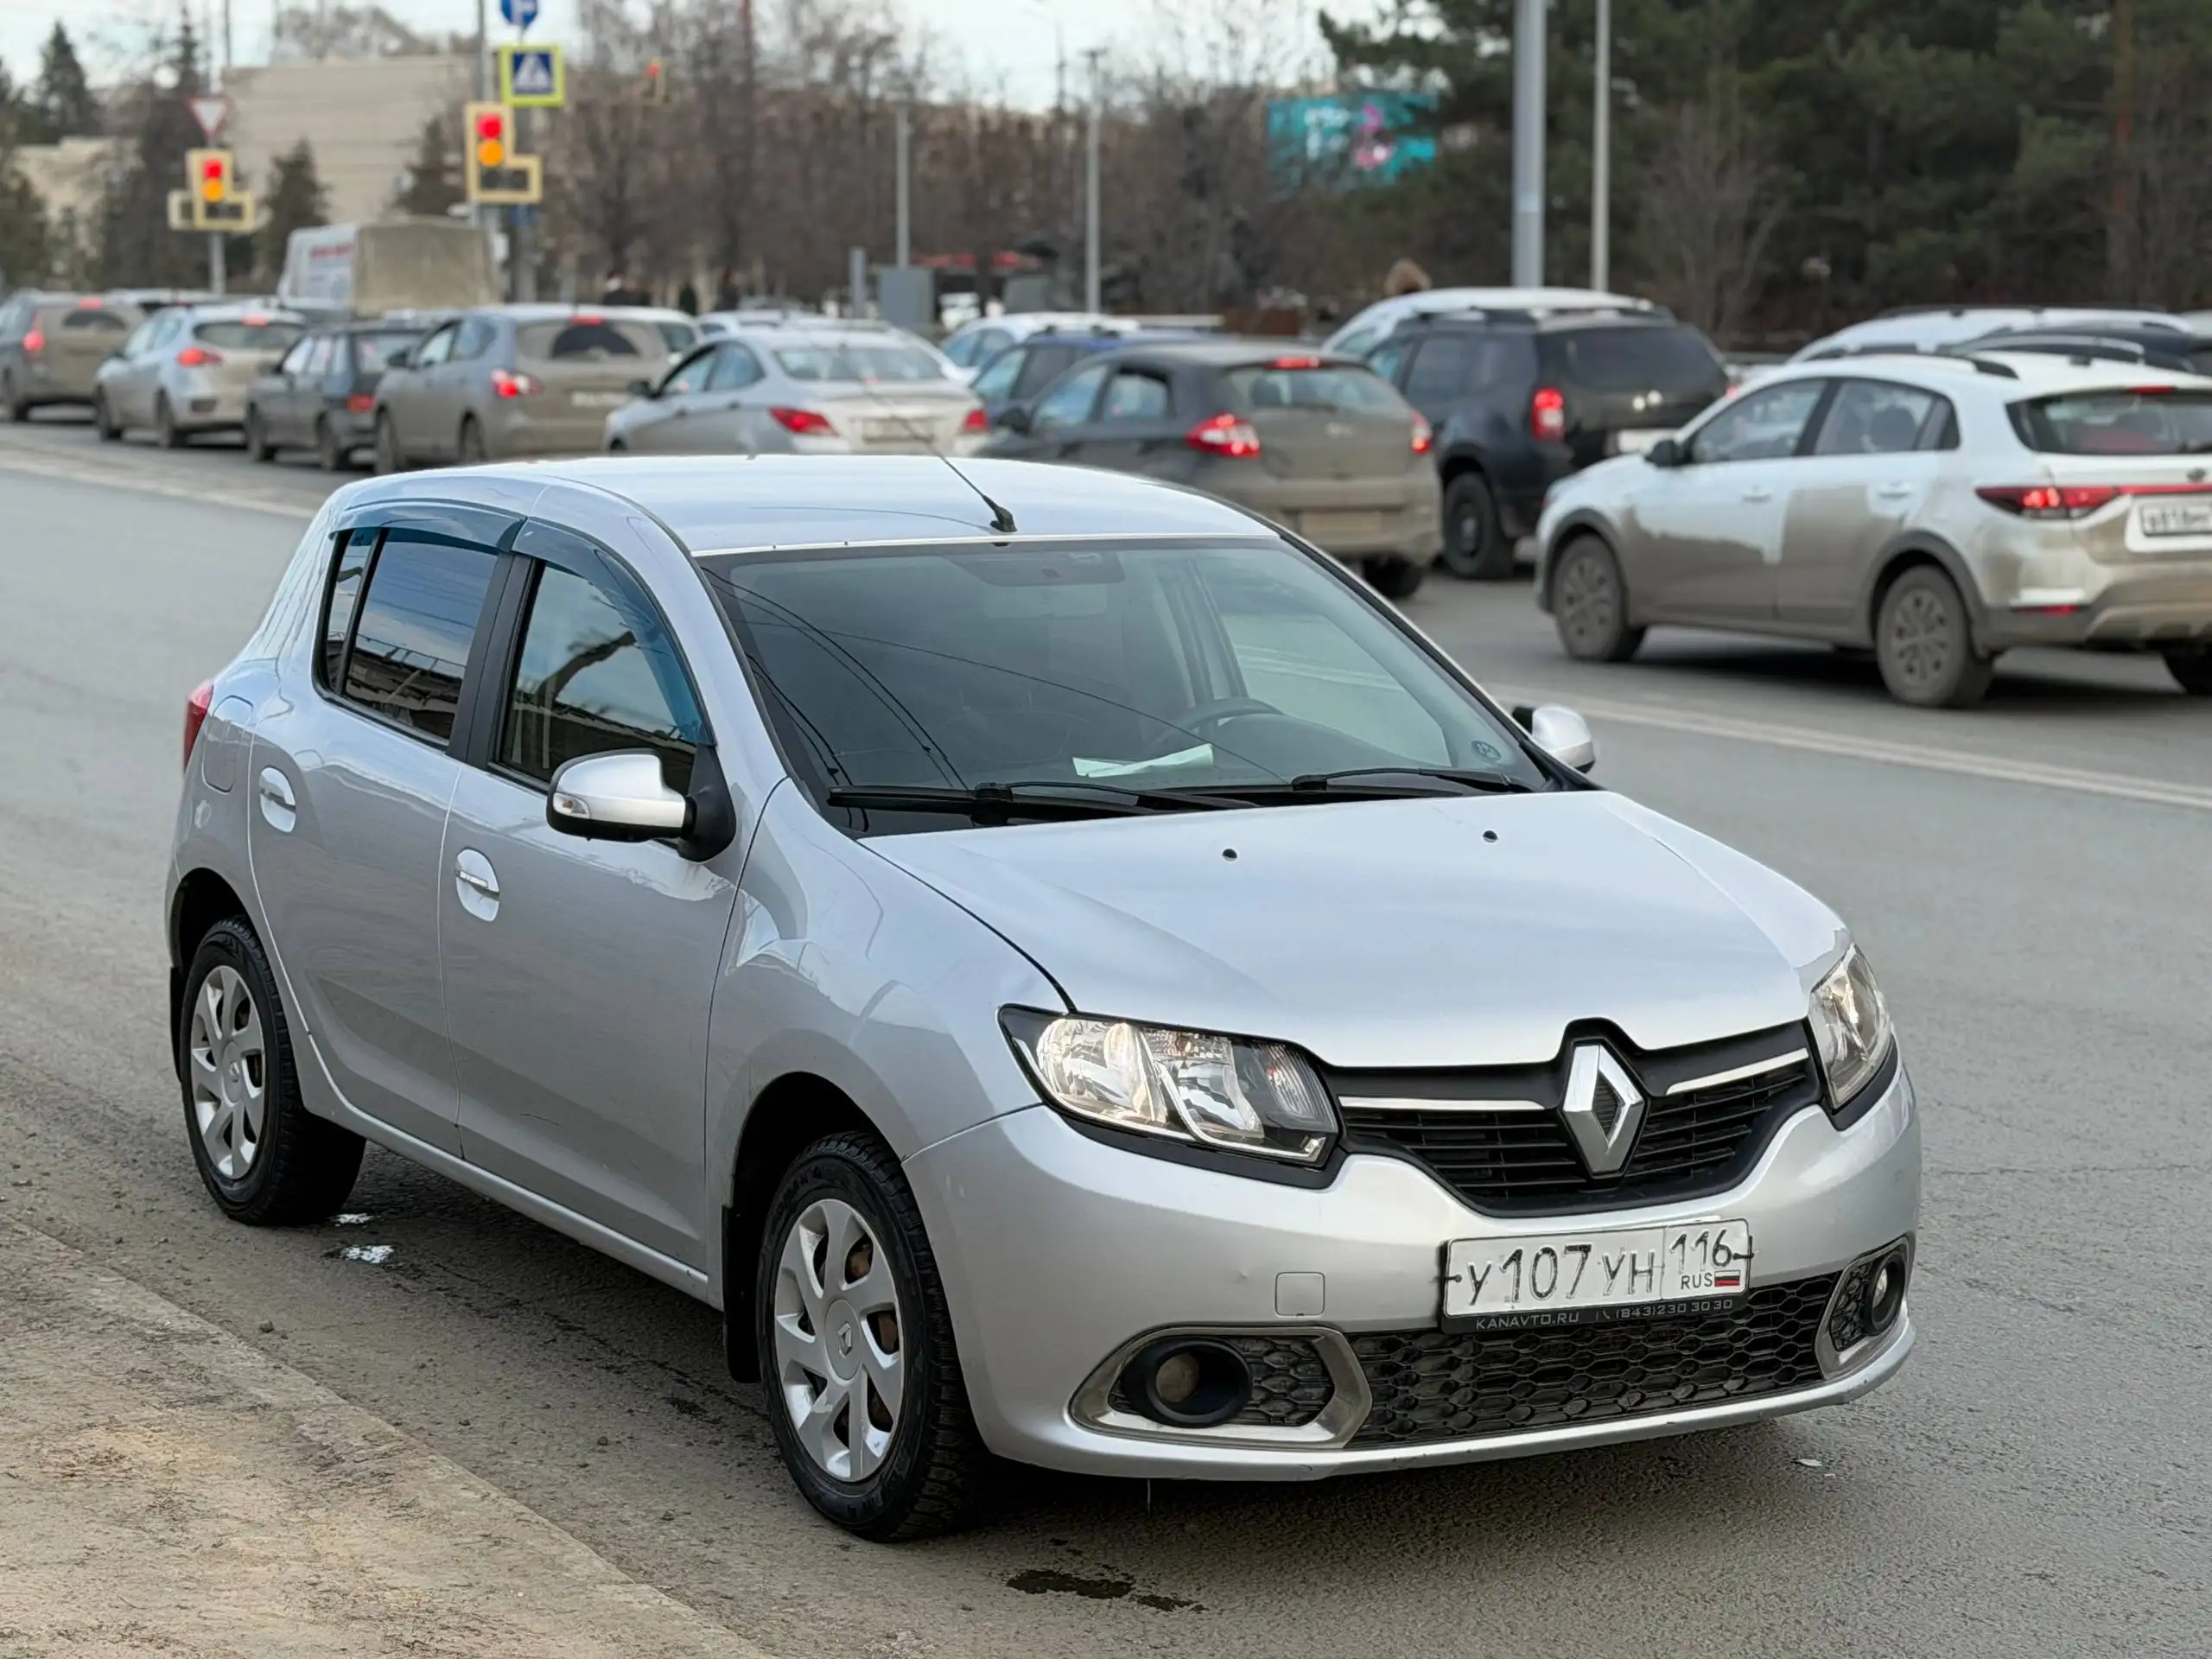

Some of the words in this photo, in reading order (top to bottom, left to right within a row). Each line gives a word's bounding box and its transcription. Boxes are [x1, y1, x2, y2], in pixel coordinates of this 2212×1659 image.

[1669, 1229, 1732, 1274] 116
[1681, 1273, 1713, 1290] RUS
[1476, 1312, 1580, 1331] KANAVTO.RU
